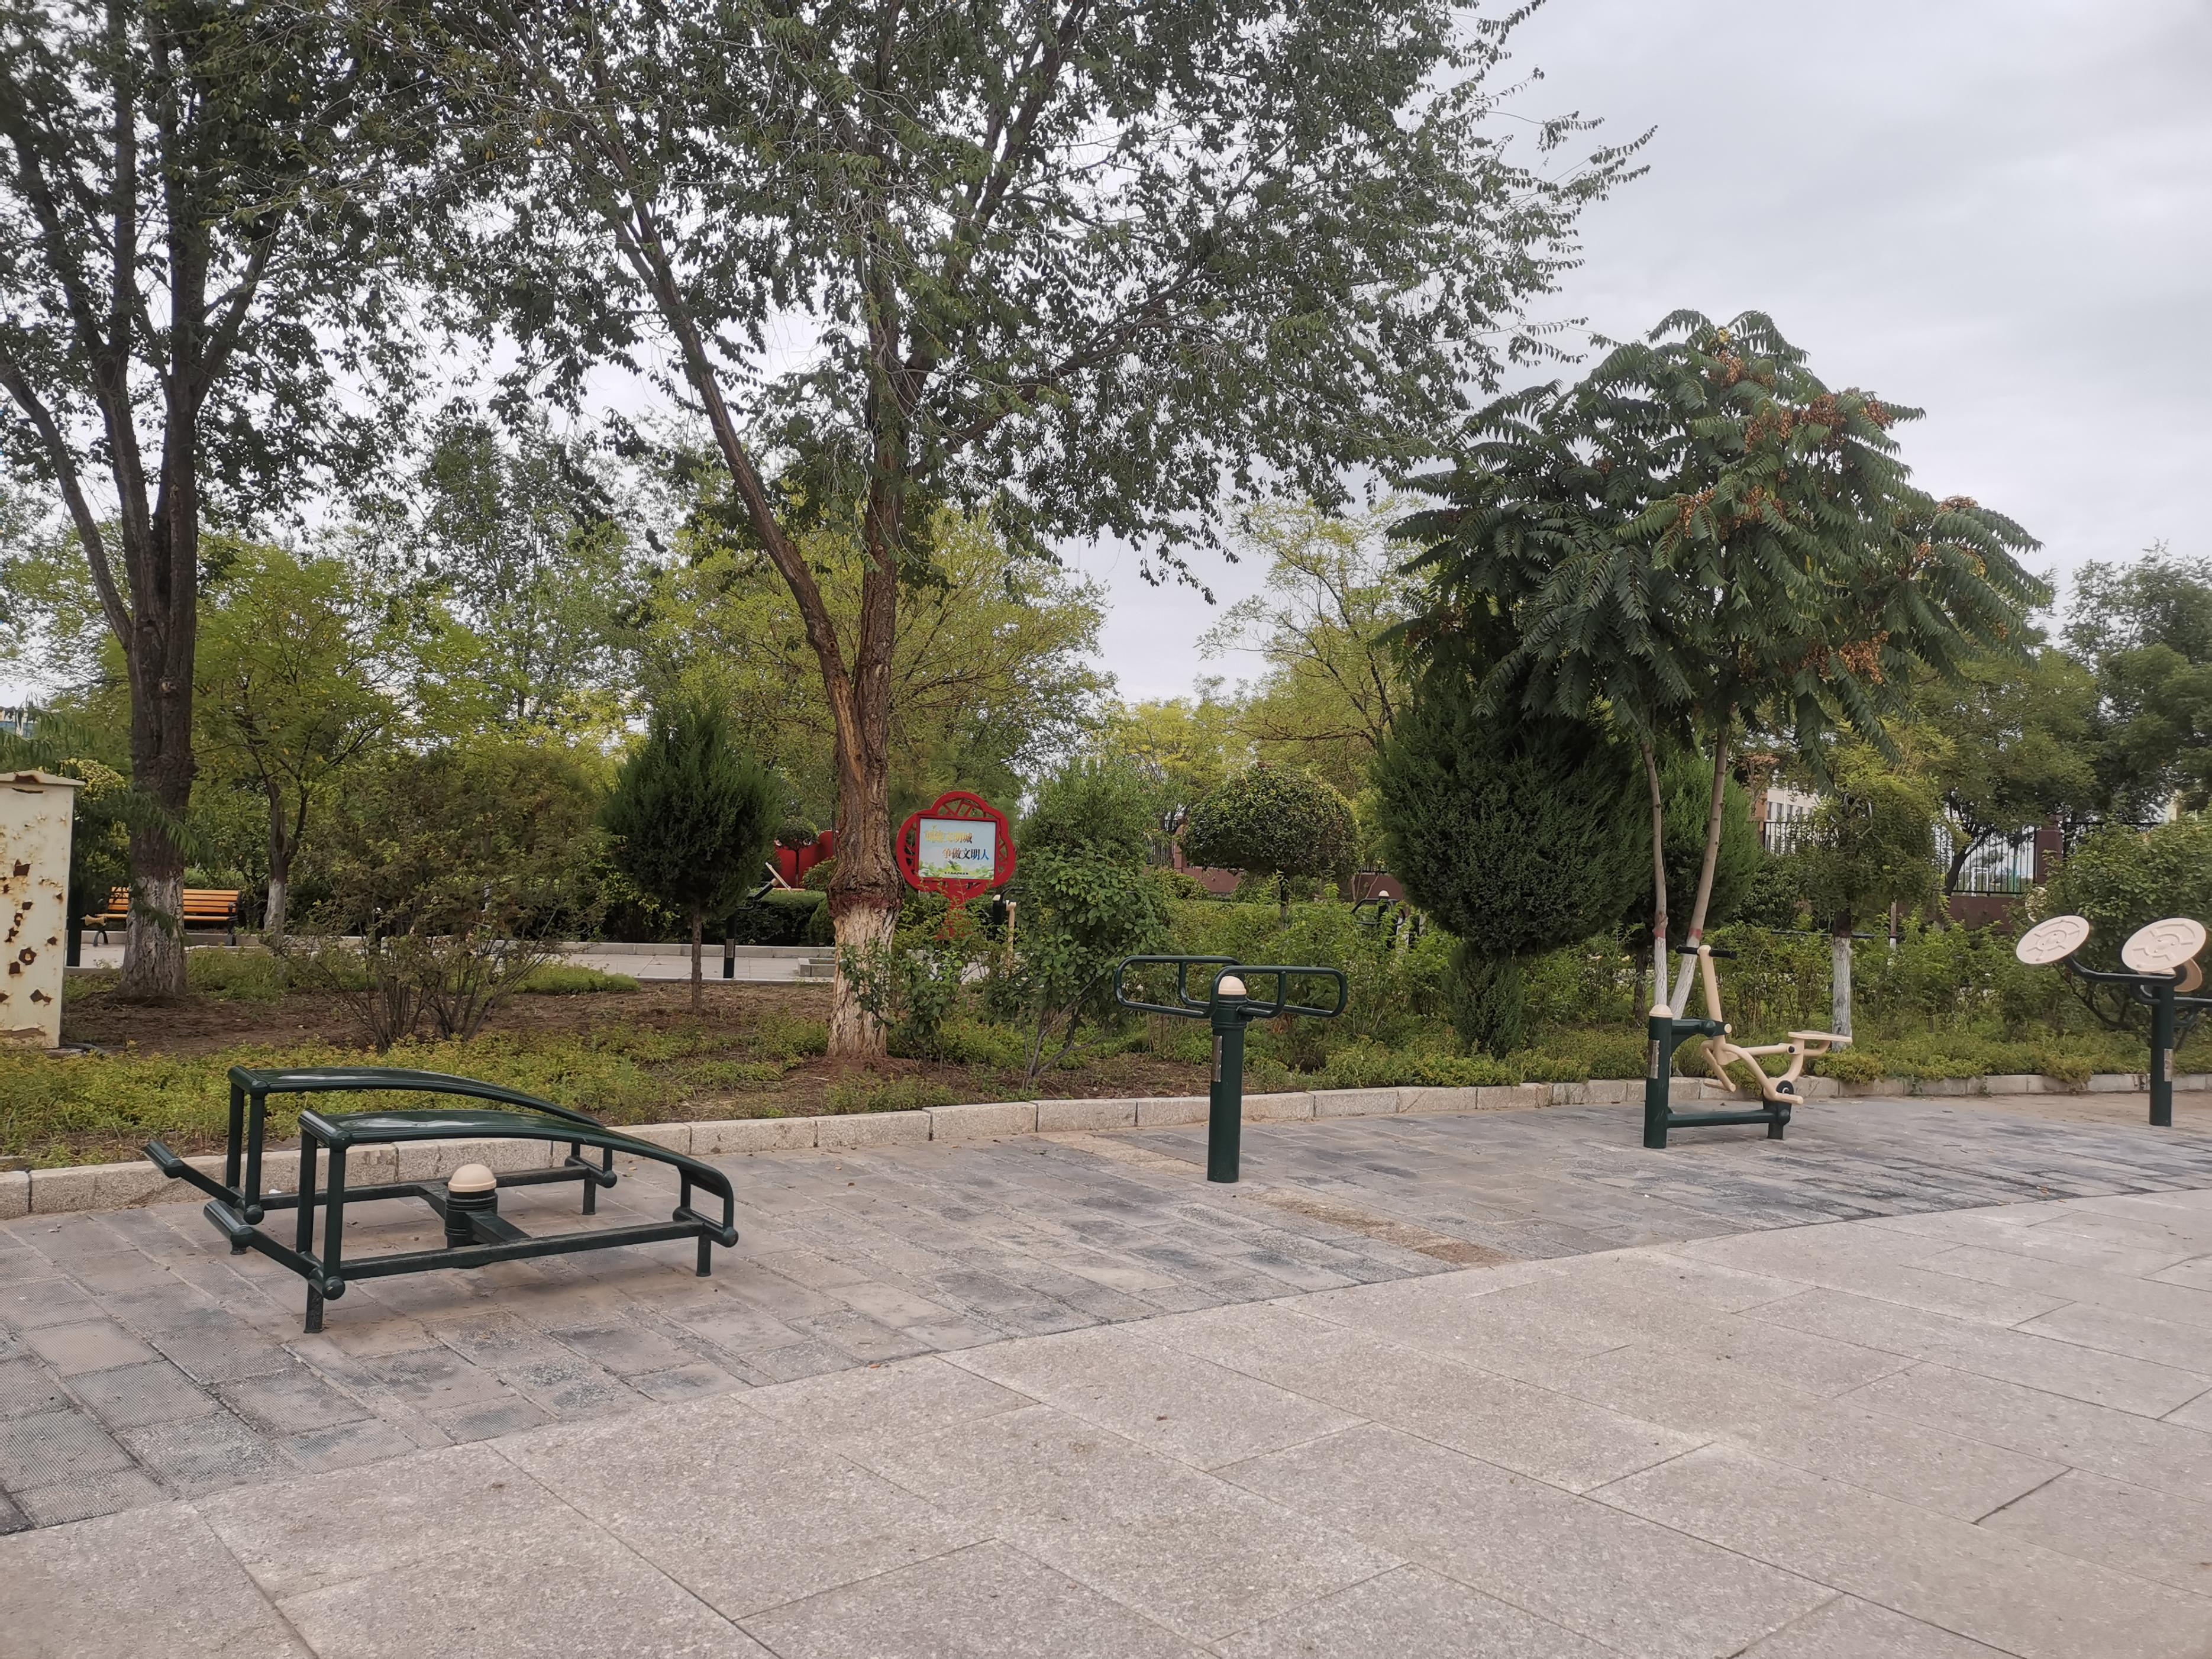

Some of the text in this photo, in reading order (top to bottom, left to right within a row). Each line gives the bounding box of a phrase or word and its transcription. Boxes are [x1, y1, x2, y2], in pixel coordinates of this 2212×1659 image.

[942, 847, 990, 860] 争做文明人
